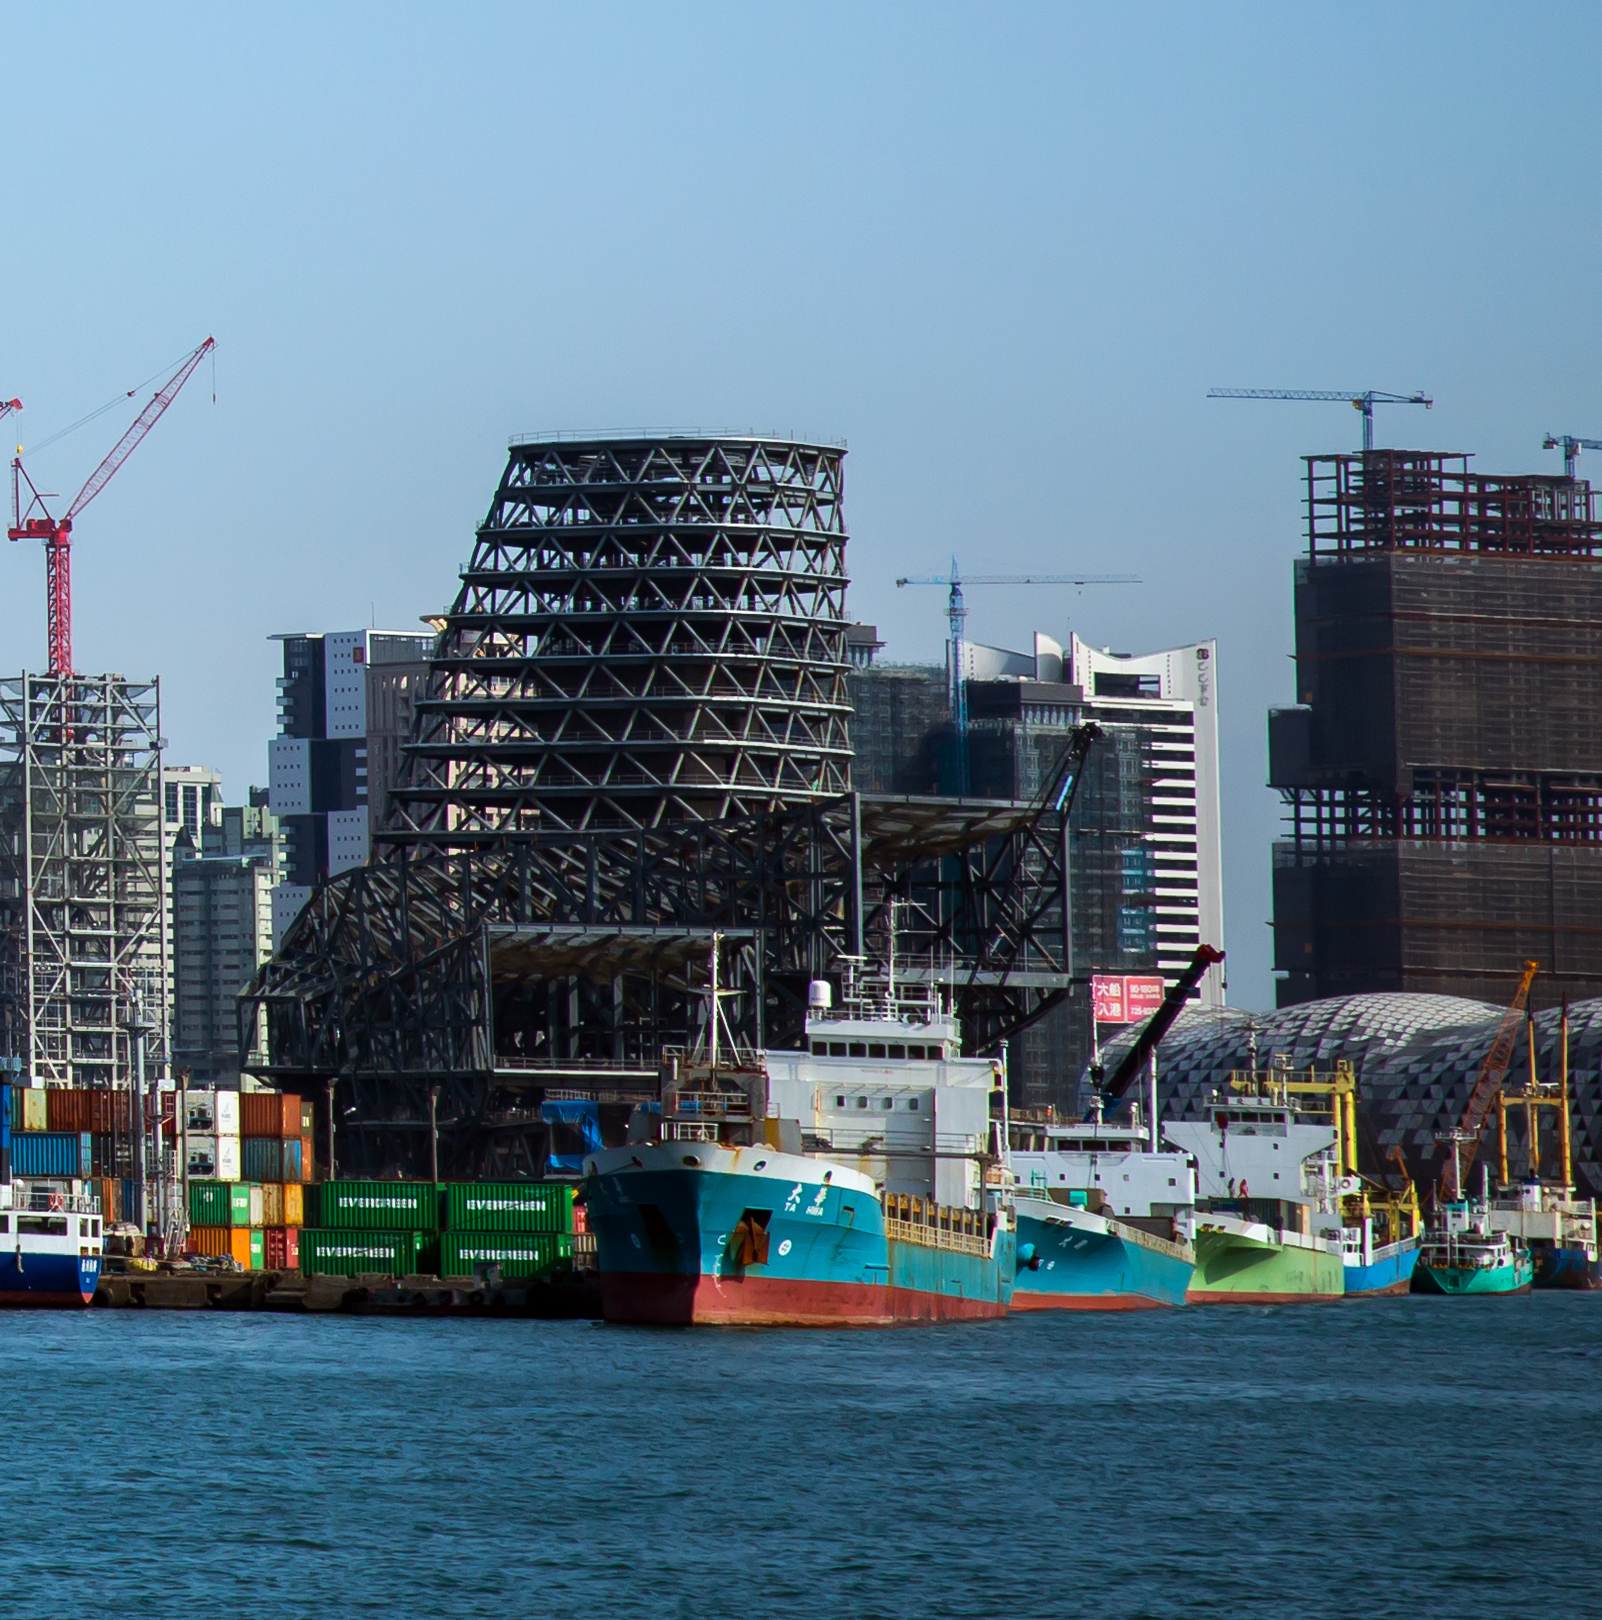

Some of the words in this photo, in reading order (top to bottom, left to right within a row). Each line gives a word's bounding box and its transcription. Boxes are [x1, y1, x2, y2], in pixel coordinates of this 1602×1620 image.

[338, 1197, 417, 1209] EVERGREEN
[467, 1199, 546, 1211] EVERGREEN
[784, 1202, 796, 1212] TA
[316, 1246, 395, 1258] EVERGREEN
[459, 1249, 539, 1260] EVERGREEN
